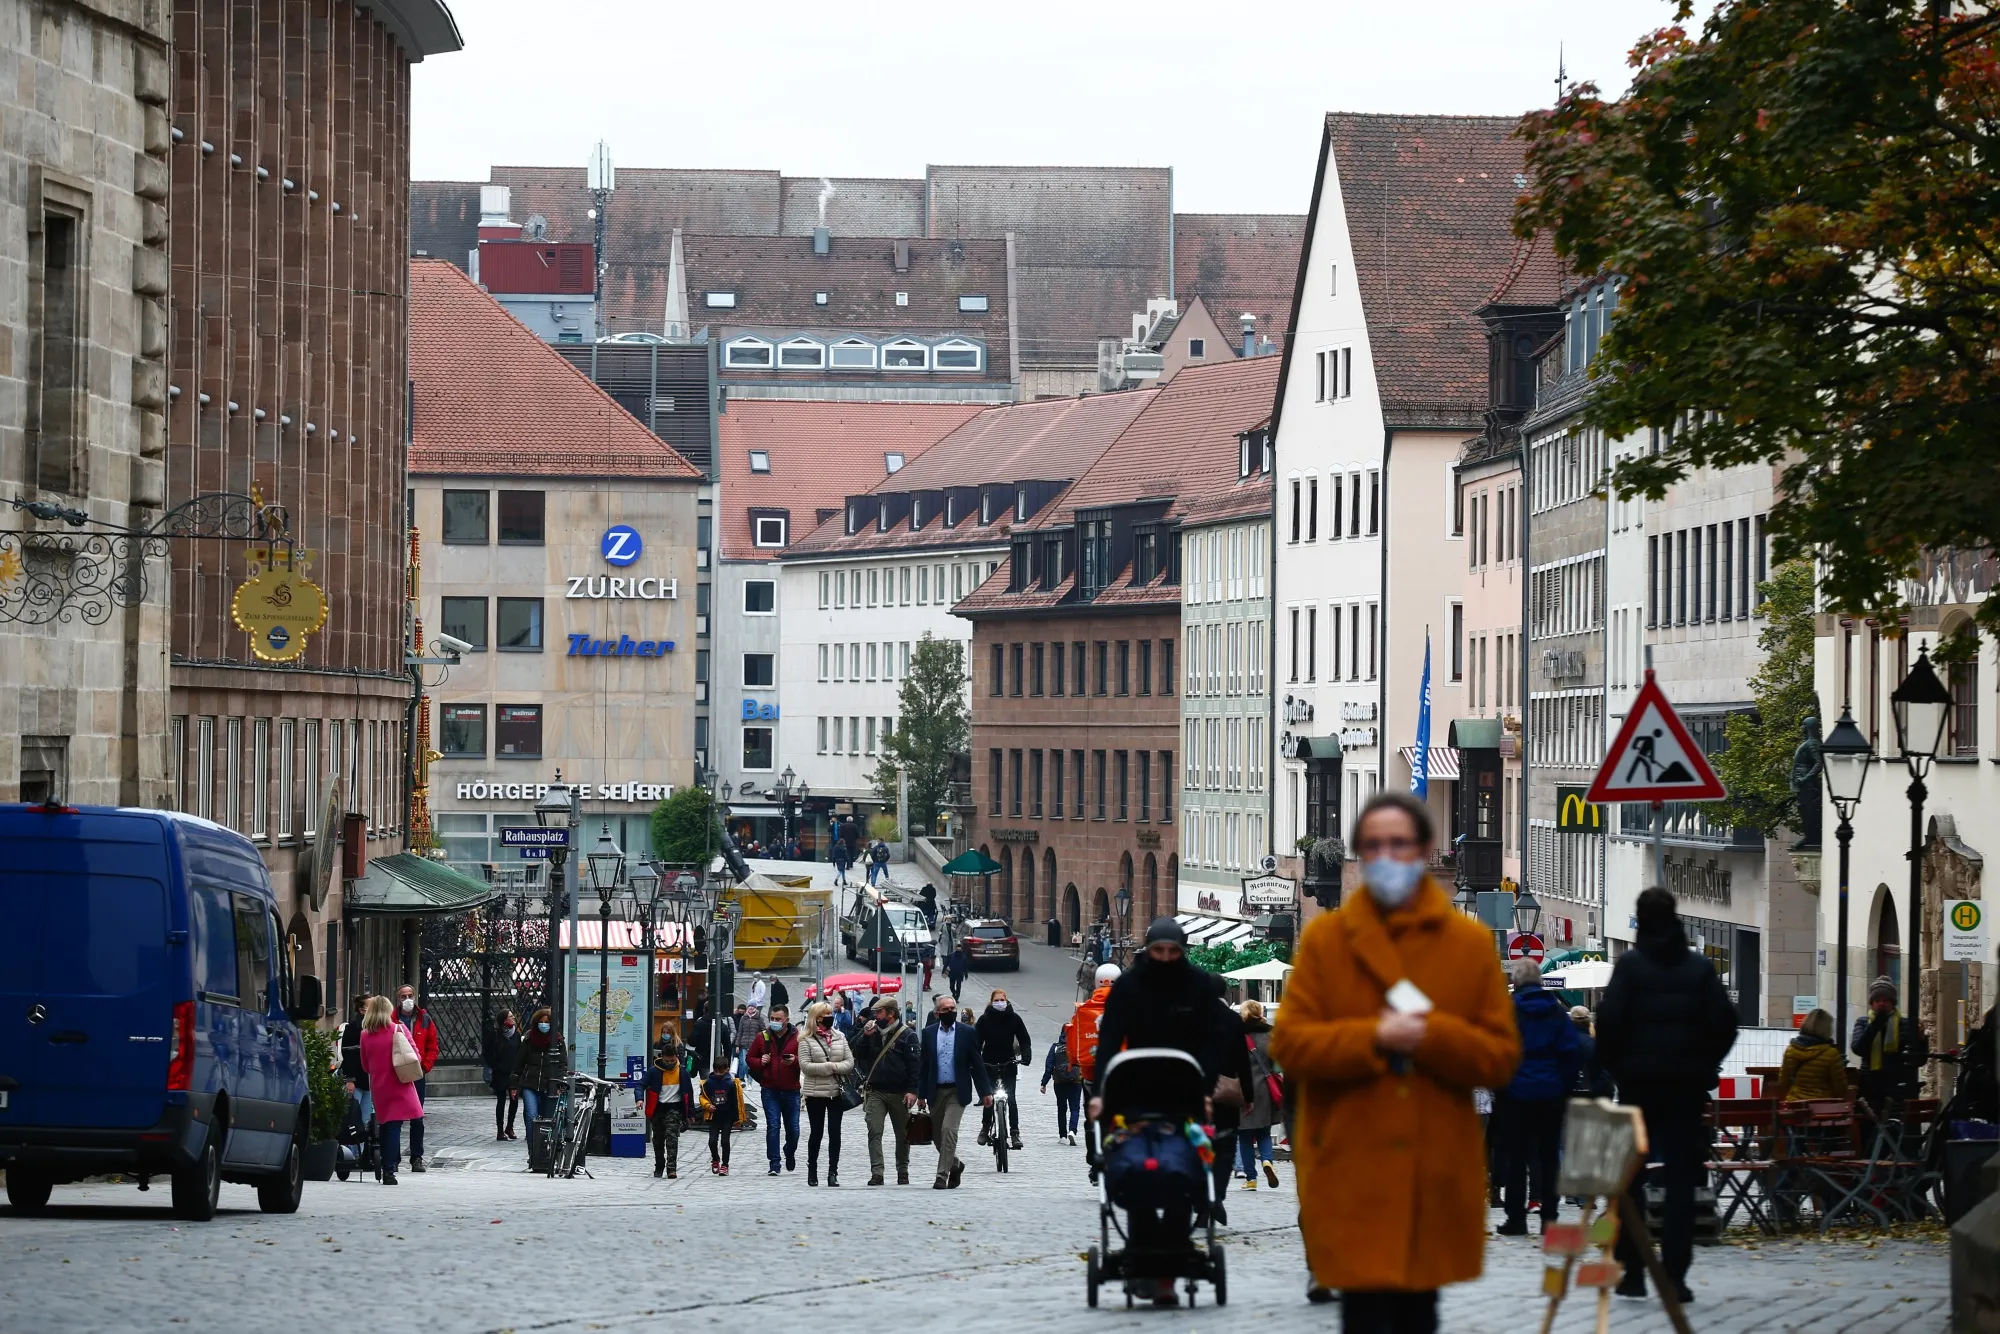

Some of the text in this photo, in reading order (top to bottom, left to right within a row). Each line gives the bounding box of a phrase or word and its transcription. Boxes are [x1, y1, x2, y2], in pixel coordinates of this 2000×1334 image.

[605, 532, 636, 560] Z
[565, 576, 678, 599] ZURICH
[567, 633, 675, 657] Tucher
[456, 779, 592, 800] HÖRGERTE
[505, 830, 564, 844] Rathausplatz
[526, 849, 531, 857] 6
[538, 849, 546, 857] 10
[1249, 881, 1290, 891] Restaurant
[1960, 908, 1972, 924] H
